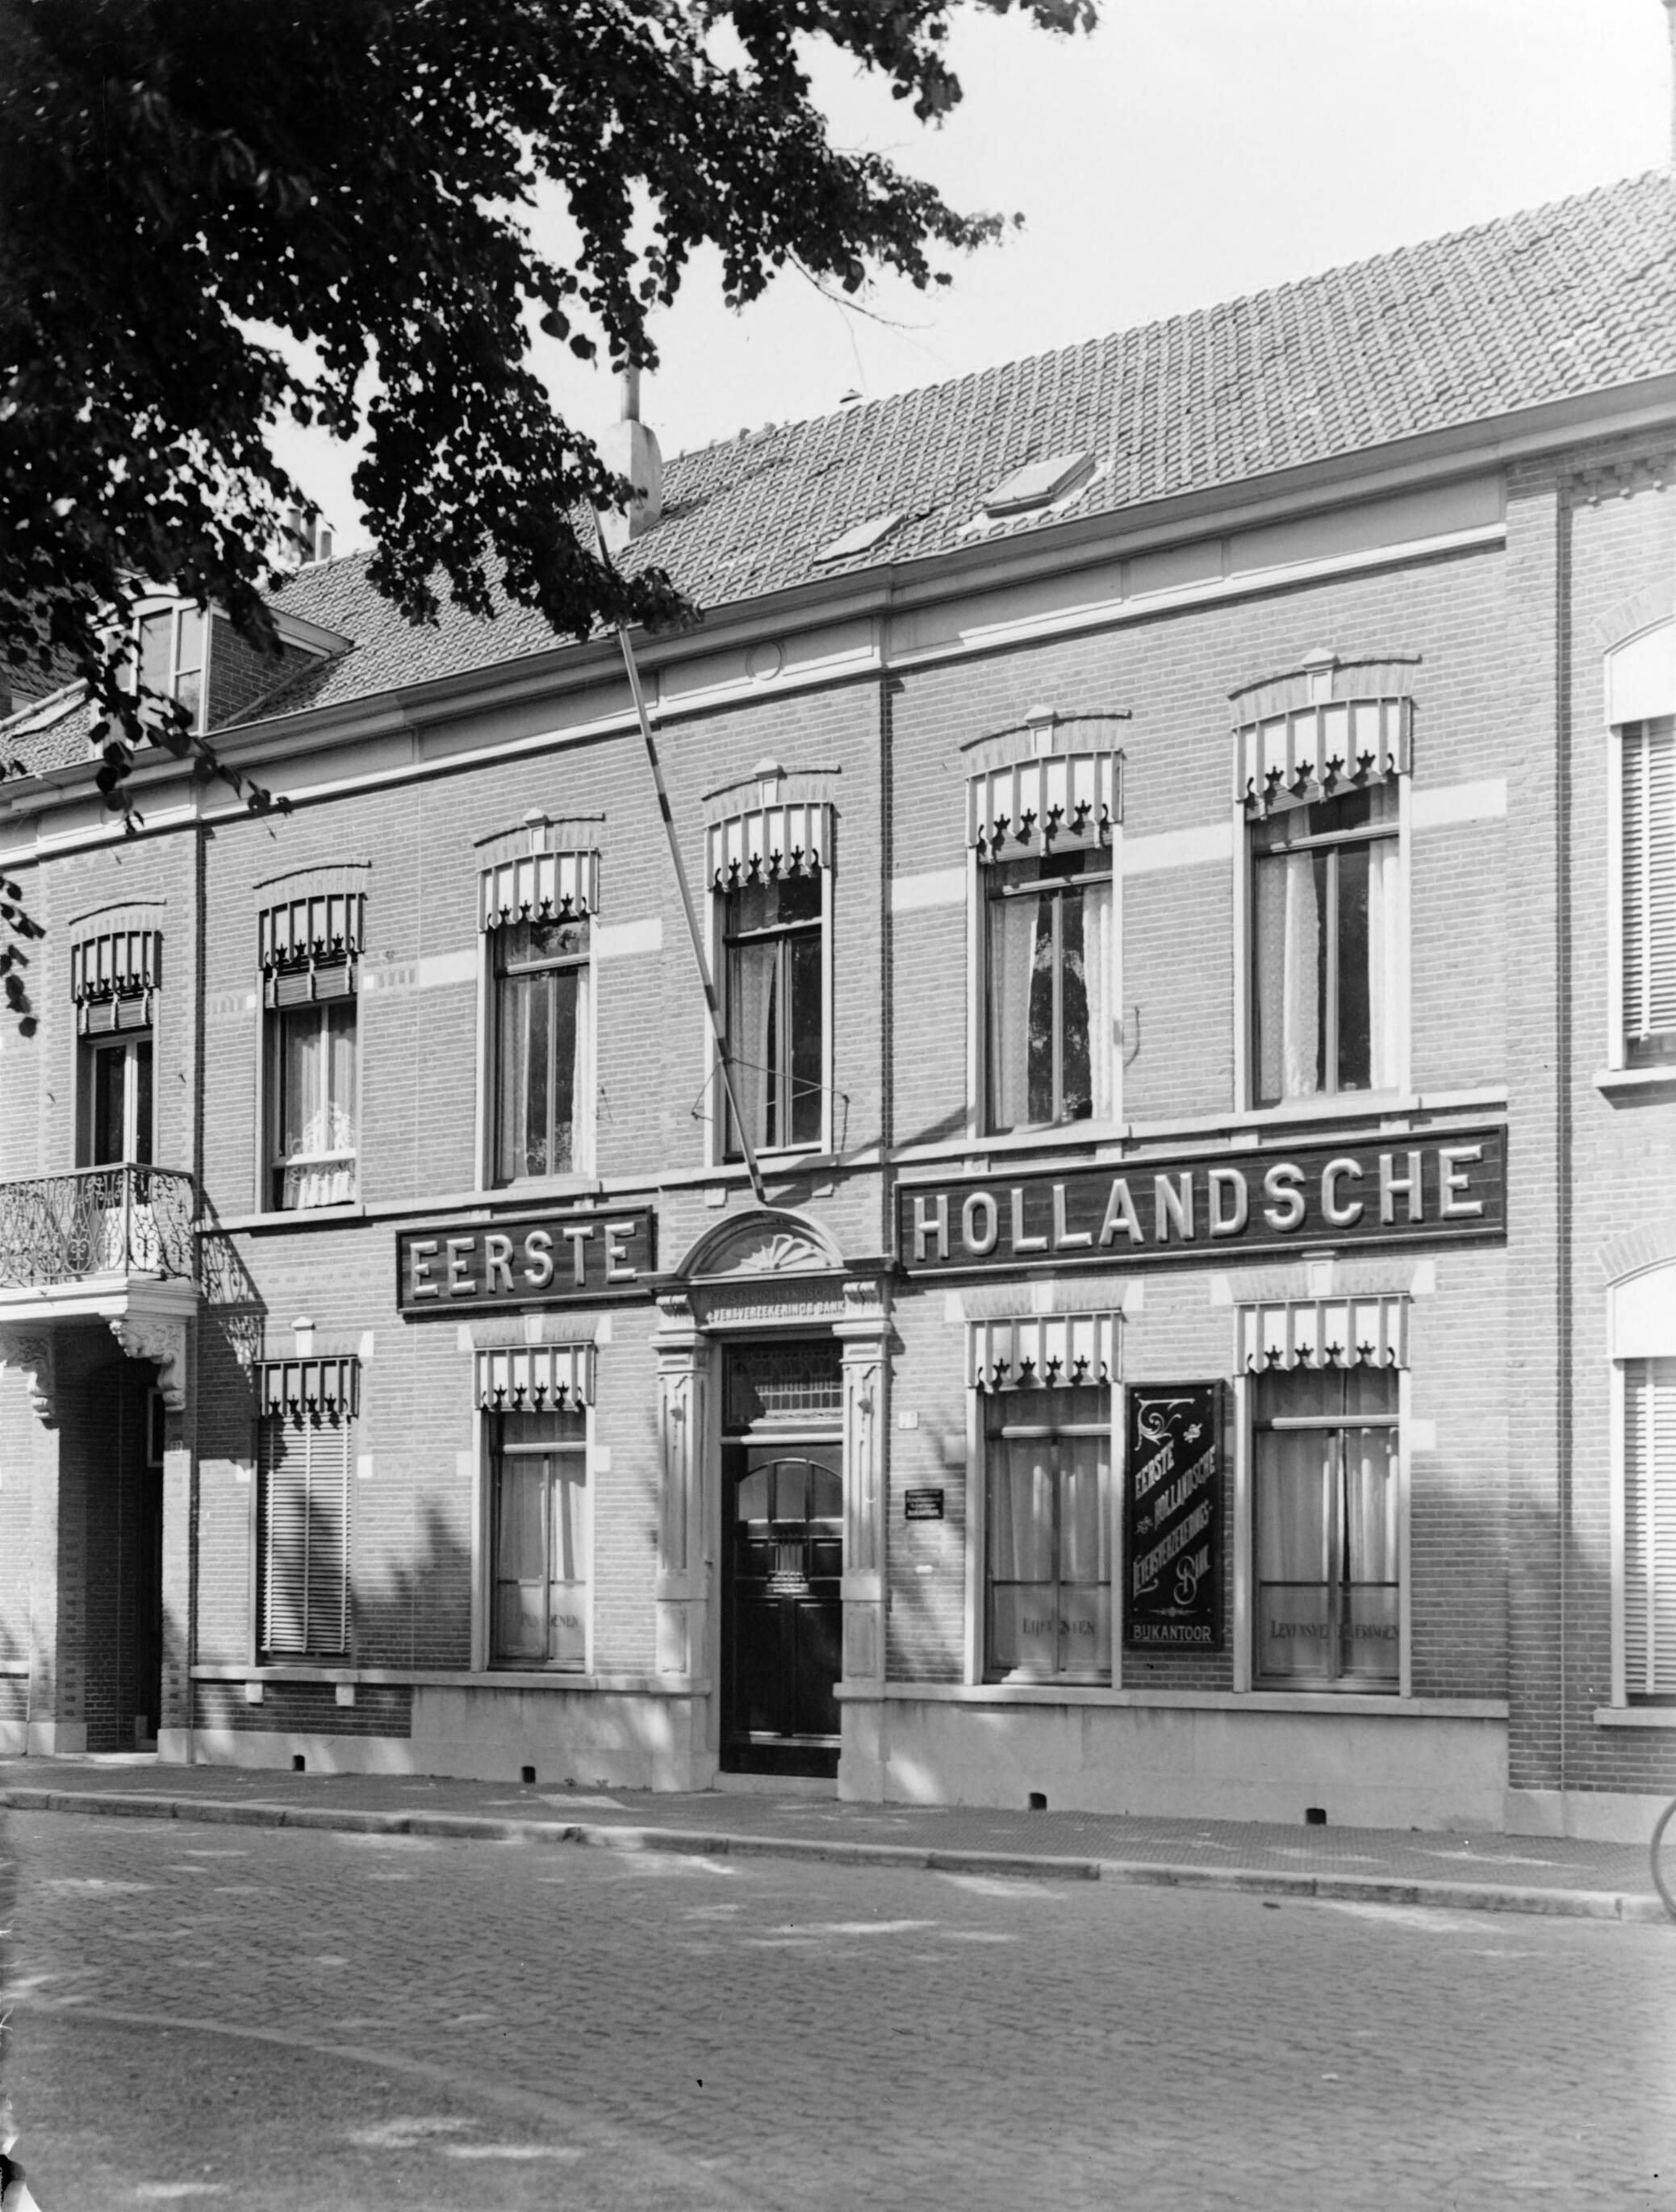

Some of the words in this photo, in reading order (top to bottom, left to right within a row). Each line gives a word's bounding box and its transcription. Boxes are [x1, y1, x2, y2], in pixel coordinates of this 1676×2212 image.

[913, 1145, 1485, 1262] HOLLANDSCHE
[410, 1222, 637, 1297] EERSTE
[1135, 1439, 1174, 1500] EERSTE
[1154, 1444, 1216, 1530] HOLLANDSCHE
[1134, 1624, 1211, 1641] BIJKANTOOR
